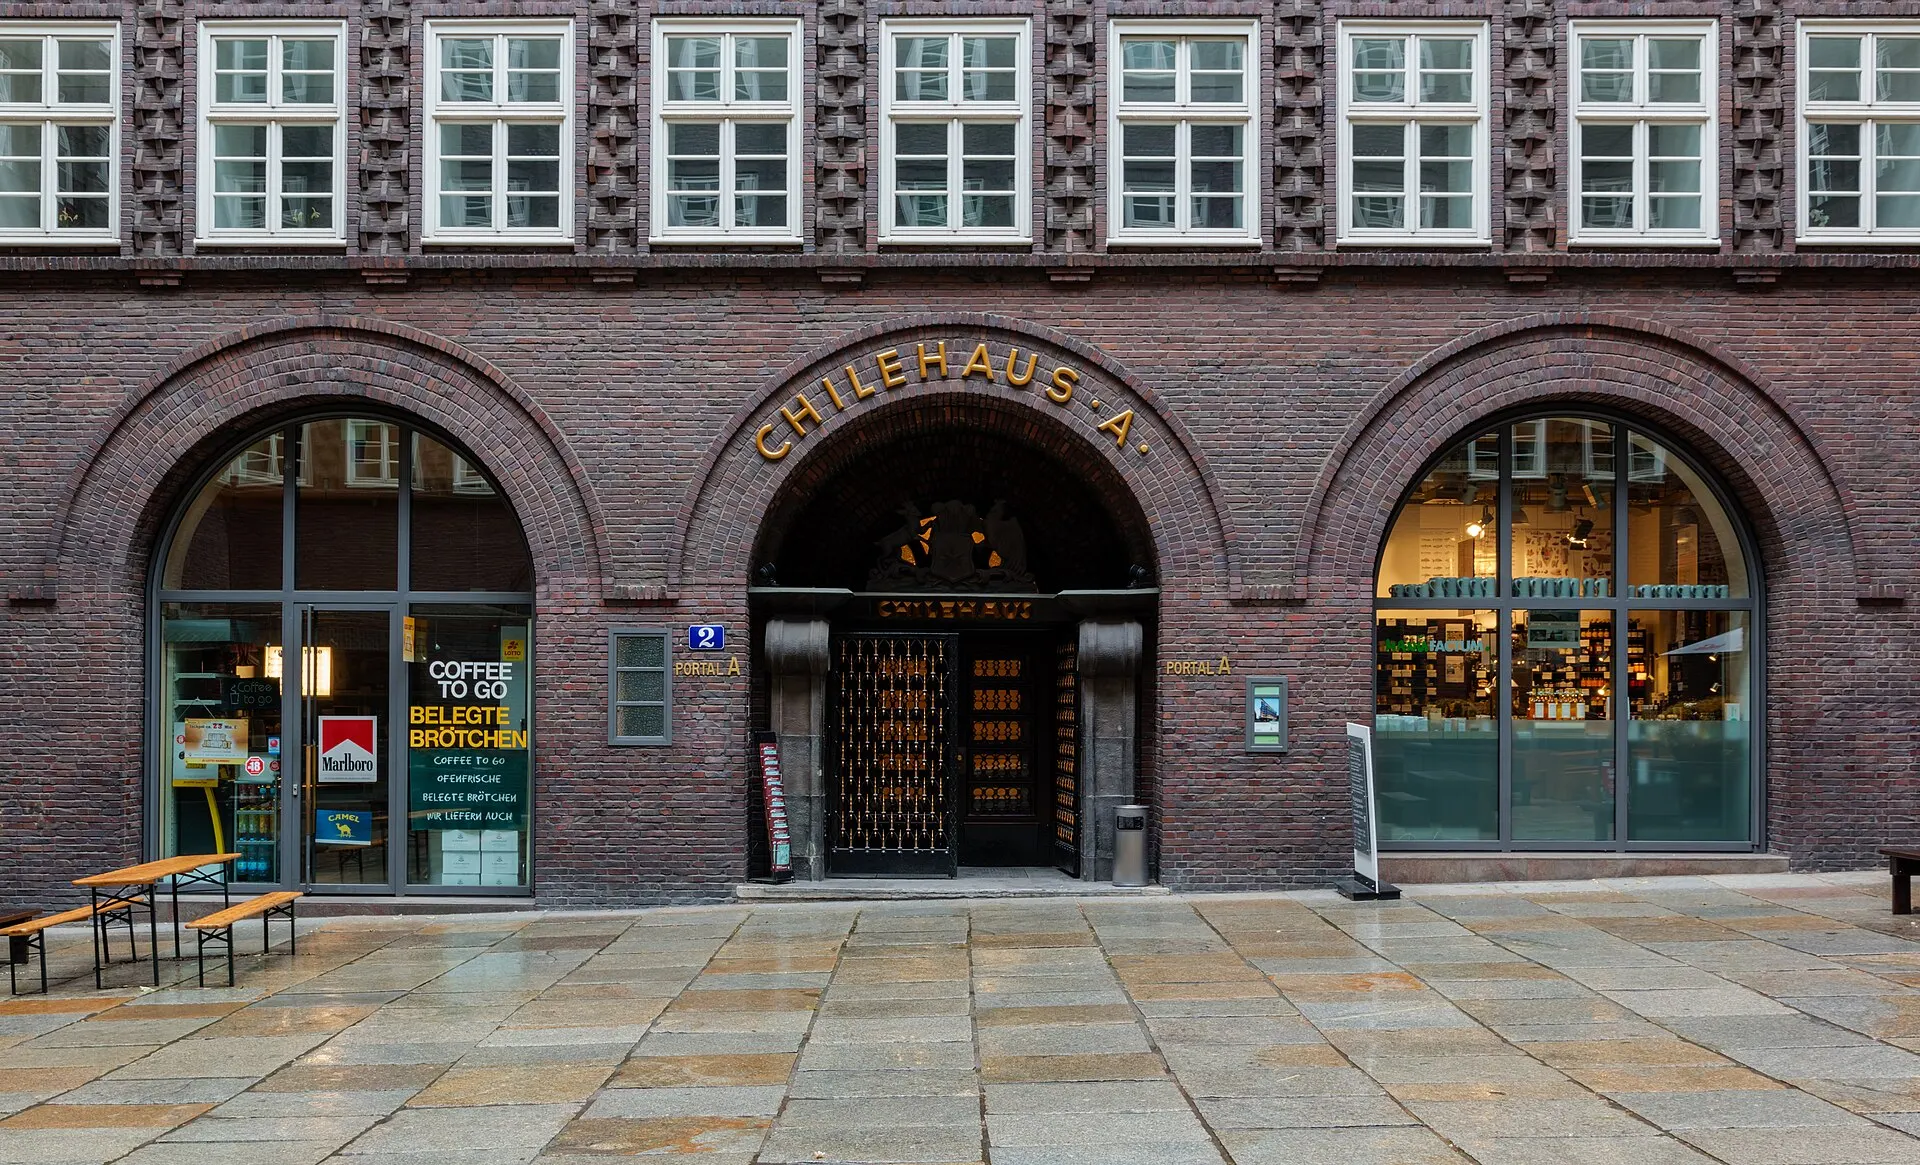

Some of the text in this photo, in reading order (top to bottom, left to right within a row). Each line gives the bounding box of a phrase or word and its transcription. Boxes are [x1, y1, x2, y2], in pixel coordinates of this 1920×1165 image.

[755, 341, 1080, 460] CHILEHAUS
[878, 600, 1032, 620] CHILEHAUS
[698, 627, 714, 648] 2
[429, 660, 512, 680] COFFEE
[675, 656, 740, 676] PORTAL A
[1166, 656, 1231, 675] PORTAL A
[238, 681, 272, 693] Coffee
[438, 680, 508, 699] TO GO
[244, 694, 272, 706] to go
[410, 706, 510, 724] BELEGTE
[410, 726, 527, 748] BRÖTCHEN
[322, 753, 374, 772] Marlboro
[434, 756, 505, 765] COFFEE TO GO
[436, 774, 501, 784] OFENFRISCHE
[422, 790, 517, 802] BELEGTE BRÖTCHEN
[328, 813, 360, 823] CAMEL
[427, 812, 513, 820] WIR LIEFERN AUCH
